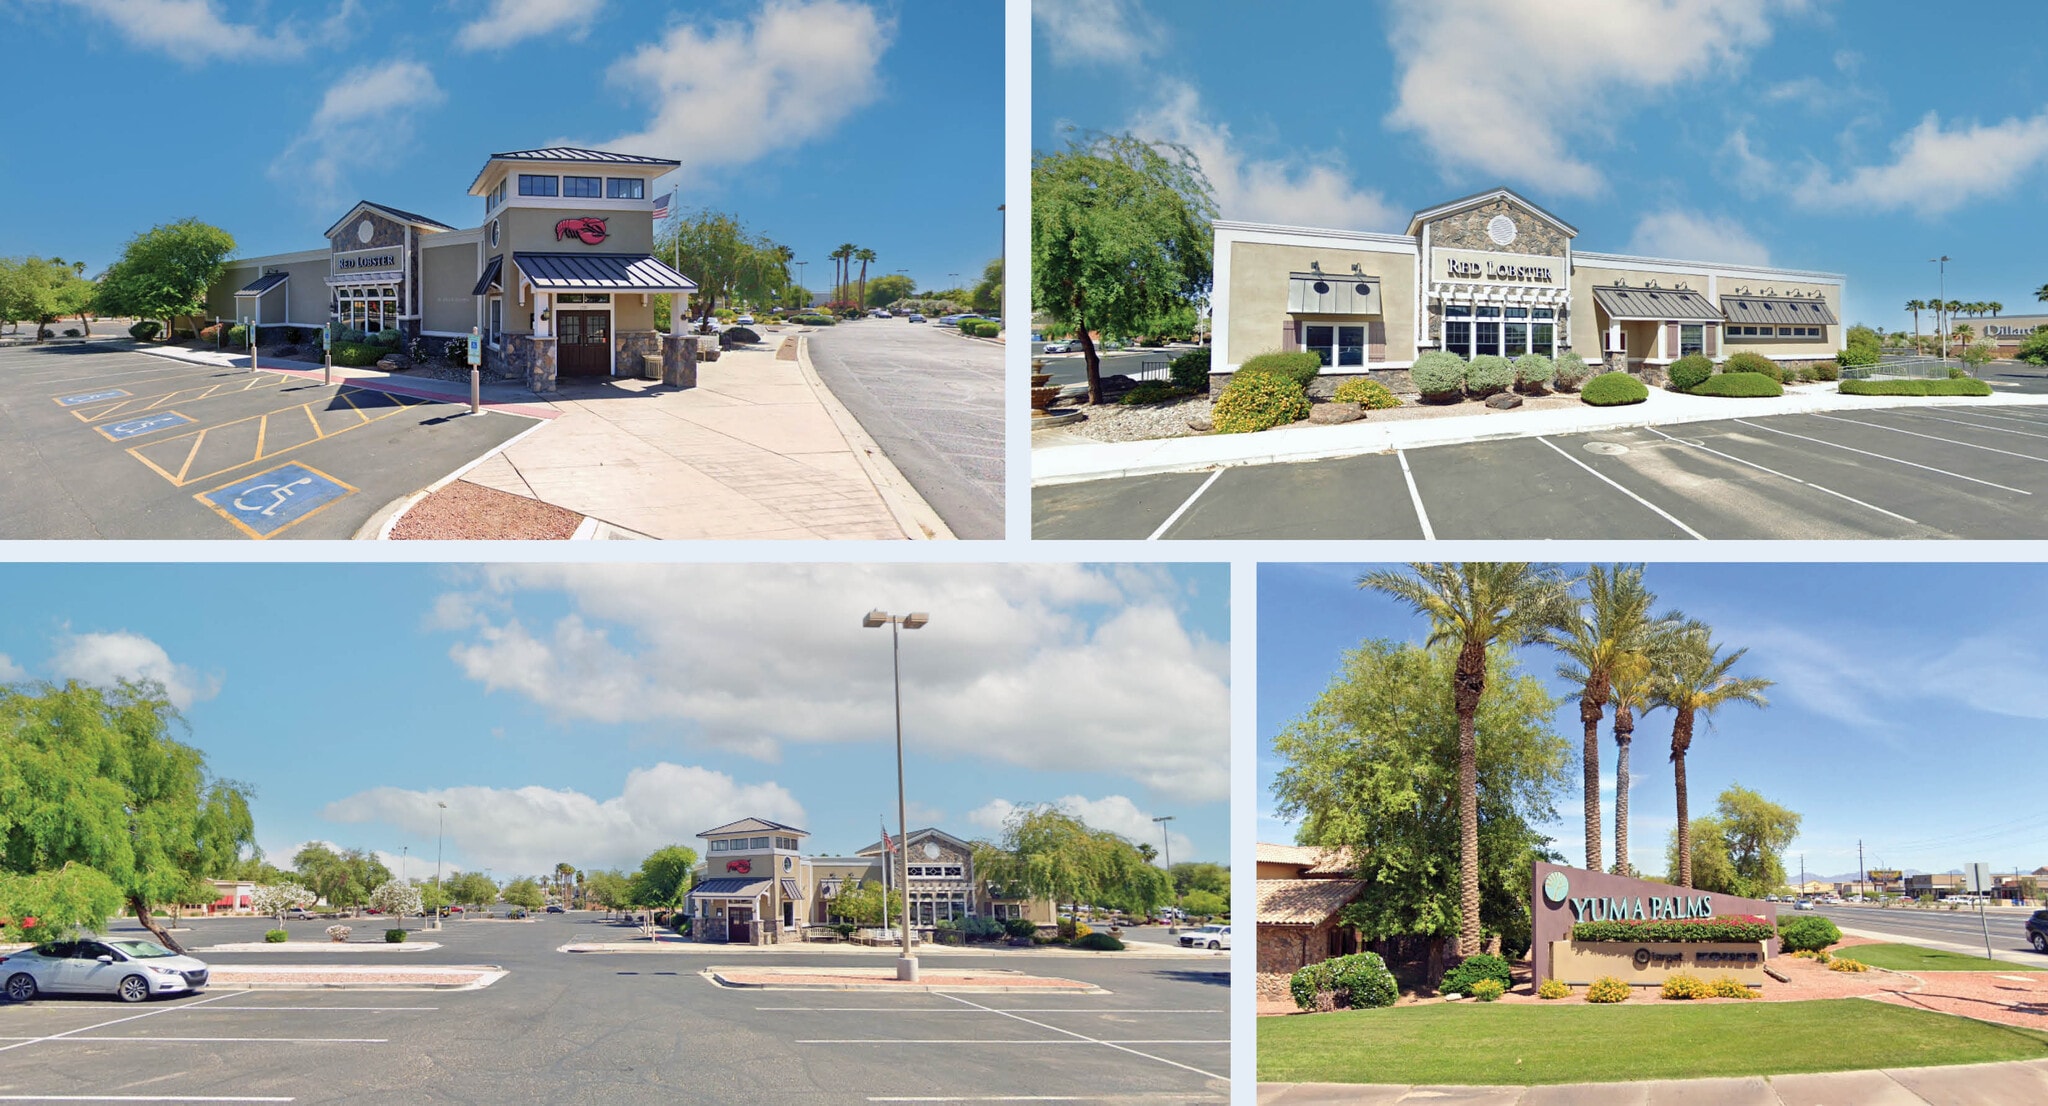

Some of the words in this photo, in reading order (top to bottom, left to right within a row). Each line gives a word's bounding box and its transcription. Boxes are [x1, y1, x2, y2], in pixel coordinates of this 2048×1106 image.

[338, 257, 355, 269] RED
[356, 255, 395, 268] LOBSTER
[1447, 258, 1482, 278] RED
[1486, 260, 1552, 282] LOBSTER
[1569, 896, 1646, 922] YUMA
[1649, 895, 1712, 919] PALMS
